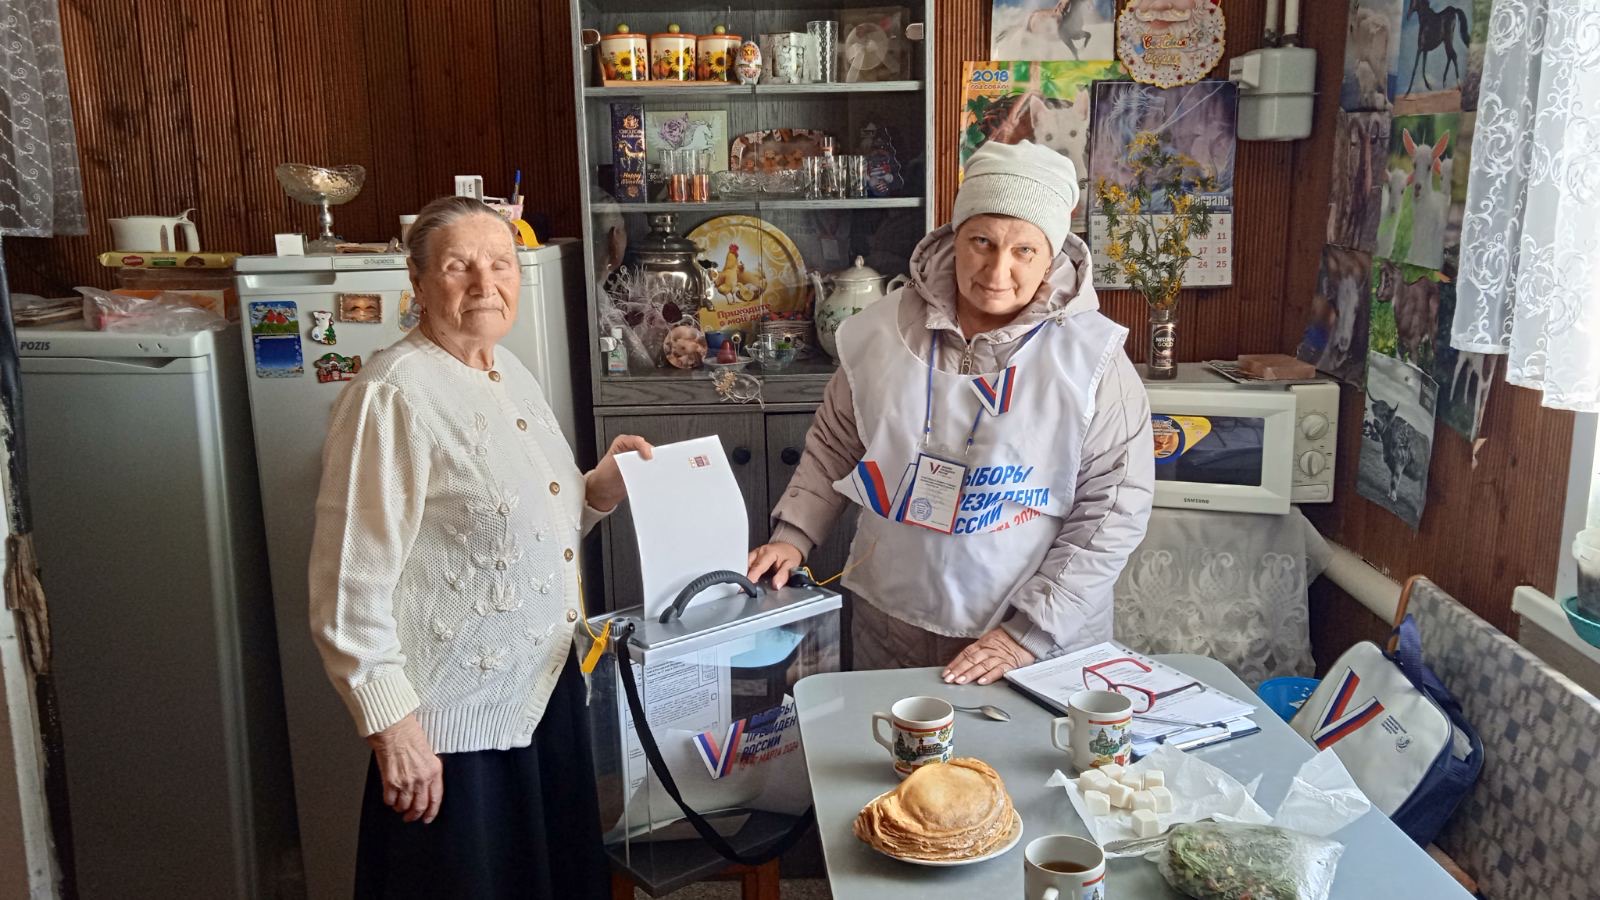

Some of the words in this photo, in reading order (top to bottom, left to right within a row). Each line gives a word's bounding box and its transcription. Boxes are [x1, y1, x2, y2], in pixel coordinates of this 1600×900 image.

[972, 70, 1009, 82] 2018
[1216, 232, 1228, 240] 11
[1216, 246, 1228, 255] 18
[1198, 260, 1209, 269] 24
[1216, 260, 1228, 269] 25
[19, 341, 51, 351] POZIS
[965, 465, 1034, 487] ЫБОРЫ
[960, 488, 1050, 512] ЕЗИДЕНТА
[953, 503, 1004, 535] ССИИ
[743, 734, 782, 755] РОССИИ
